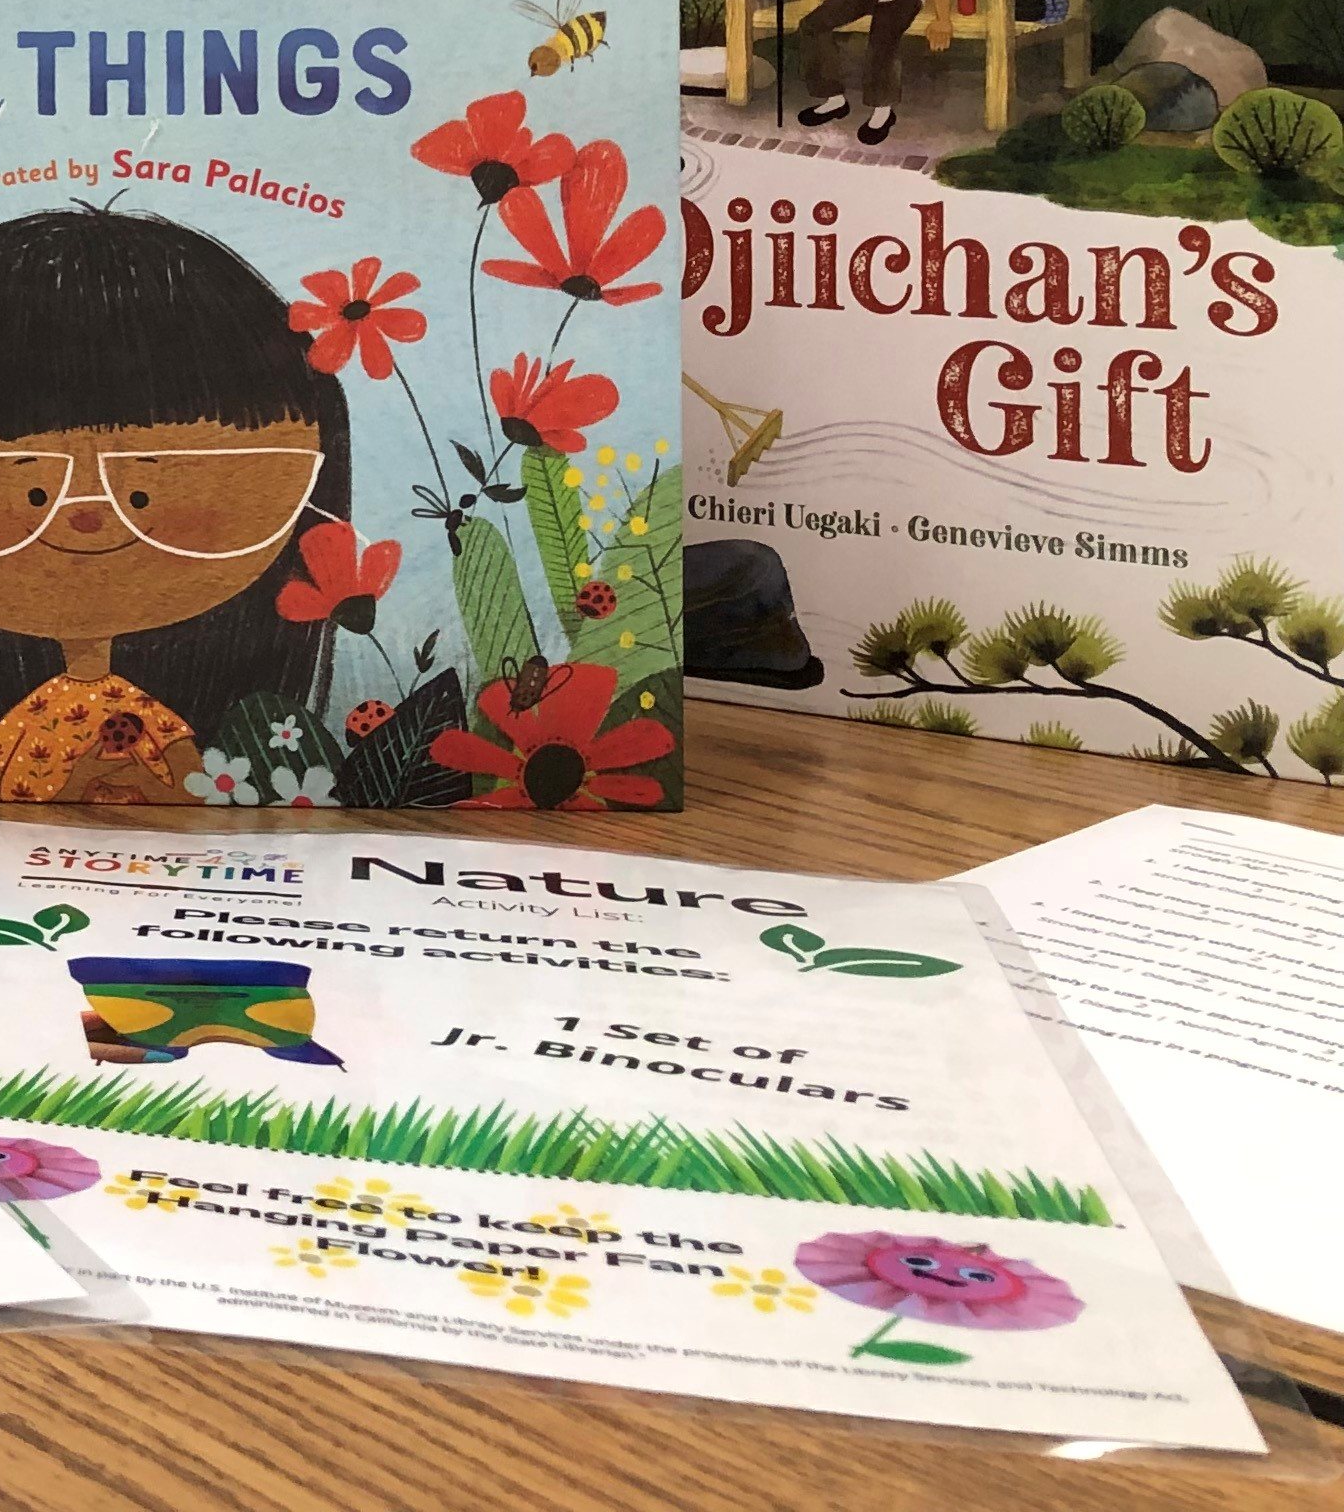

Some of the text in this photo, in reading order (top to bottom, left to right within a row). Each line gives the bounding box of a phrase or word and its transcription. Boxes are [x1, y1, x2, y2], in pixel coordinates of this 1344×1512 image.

[16, 26, 413, 120] THINGS
[67, 159, 100, 188] by
[110, 148, 191, 189] Sara
[203, 157, 348, 223] Palacios
[936, 338, 1212, 474] Gift
[686, 493, 1191, 571] Chieri Uegaki Genevieve Simms
[24, 852, 305, 885] STORYTIME
[31, 845, 192, 865] ANYTIME
[18, 881, 120, 896] Learning
[350, 855, 809, 918] Nature
[432, 895, 645, 924] Activity List:
[132, 924, 731, 983] following activities:
[173, 908, 702, 960] Please return the
[430, 1026, 912, 1112] Jr. Binoculars
[552, 1015, 810, 1065] 1 Set of
[129, 1168, 745, 1256] Feel free to keep the
[146, 1191, 726, 1279] Hanging Paper Fan
[315, 1234, 542, 1280] Flower!
